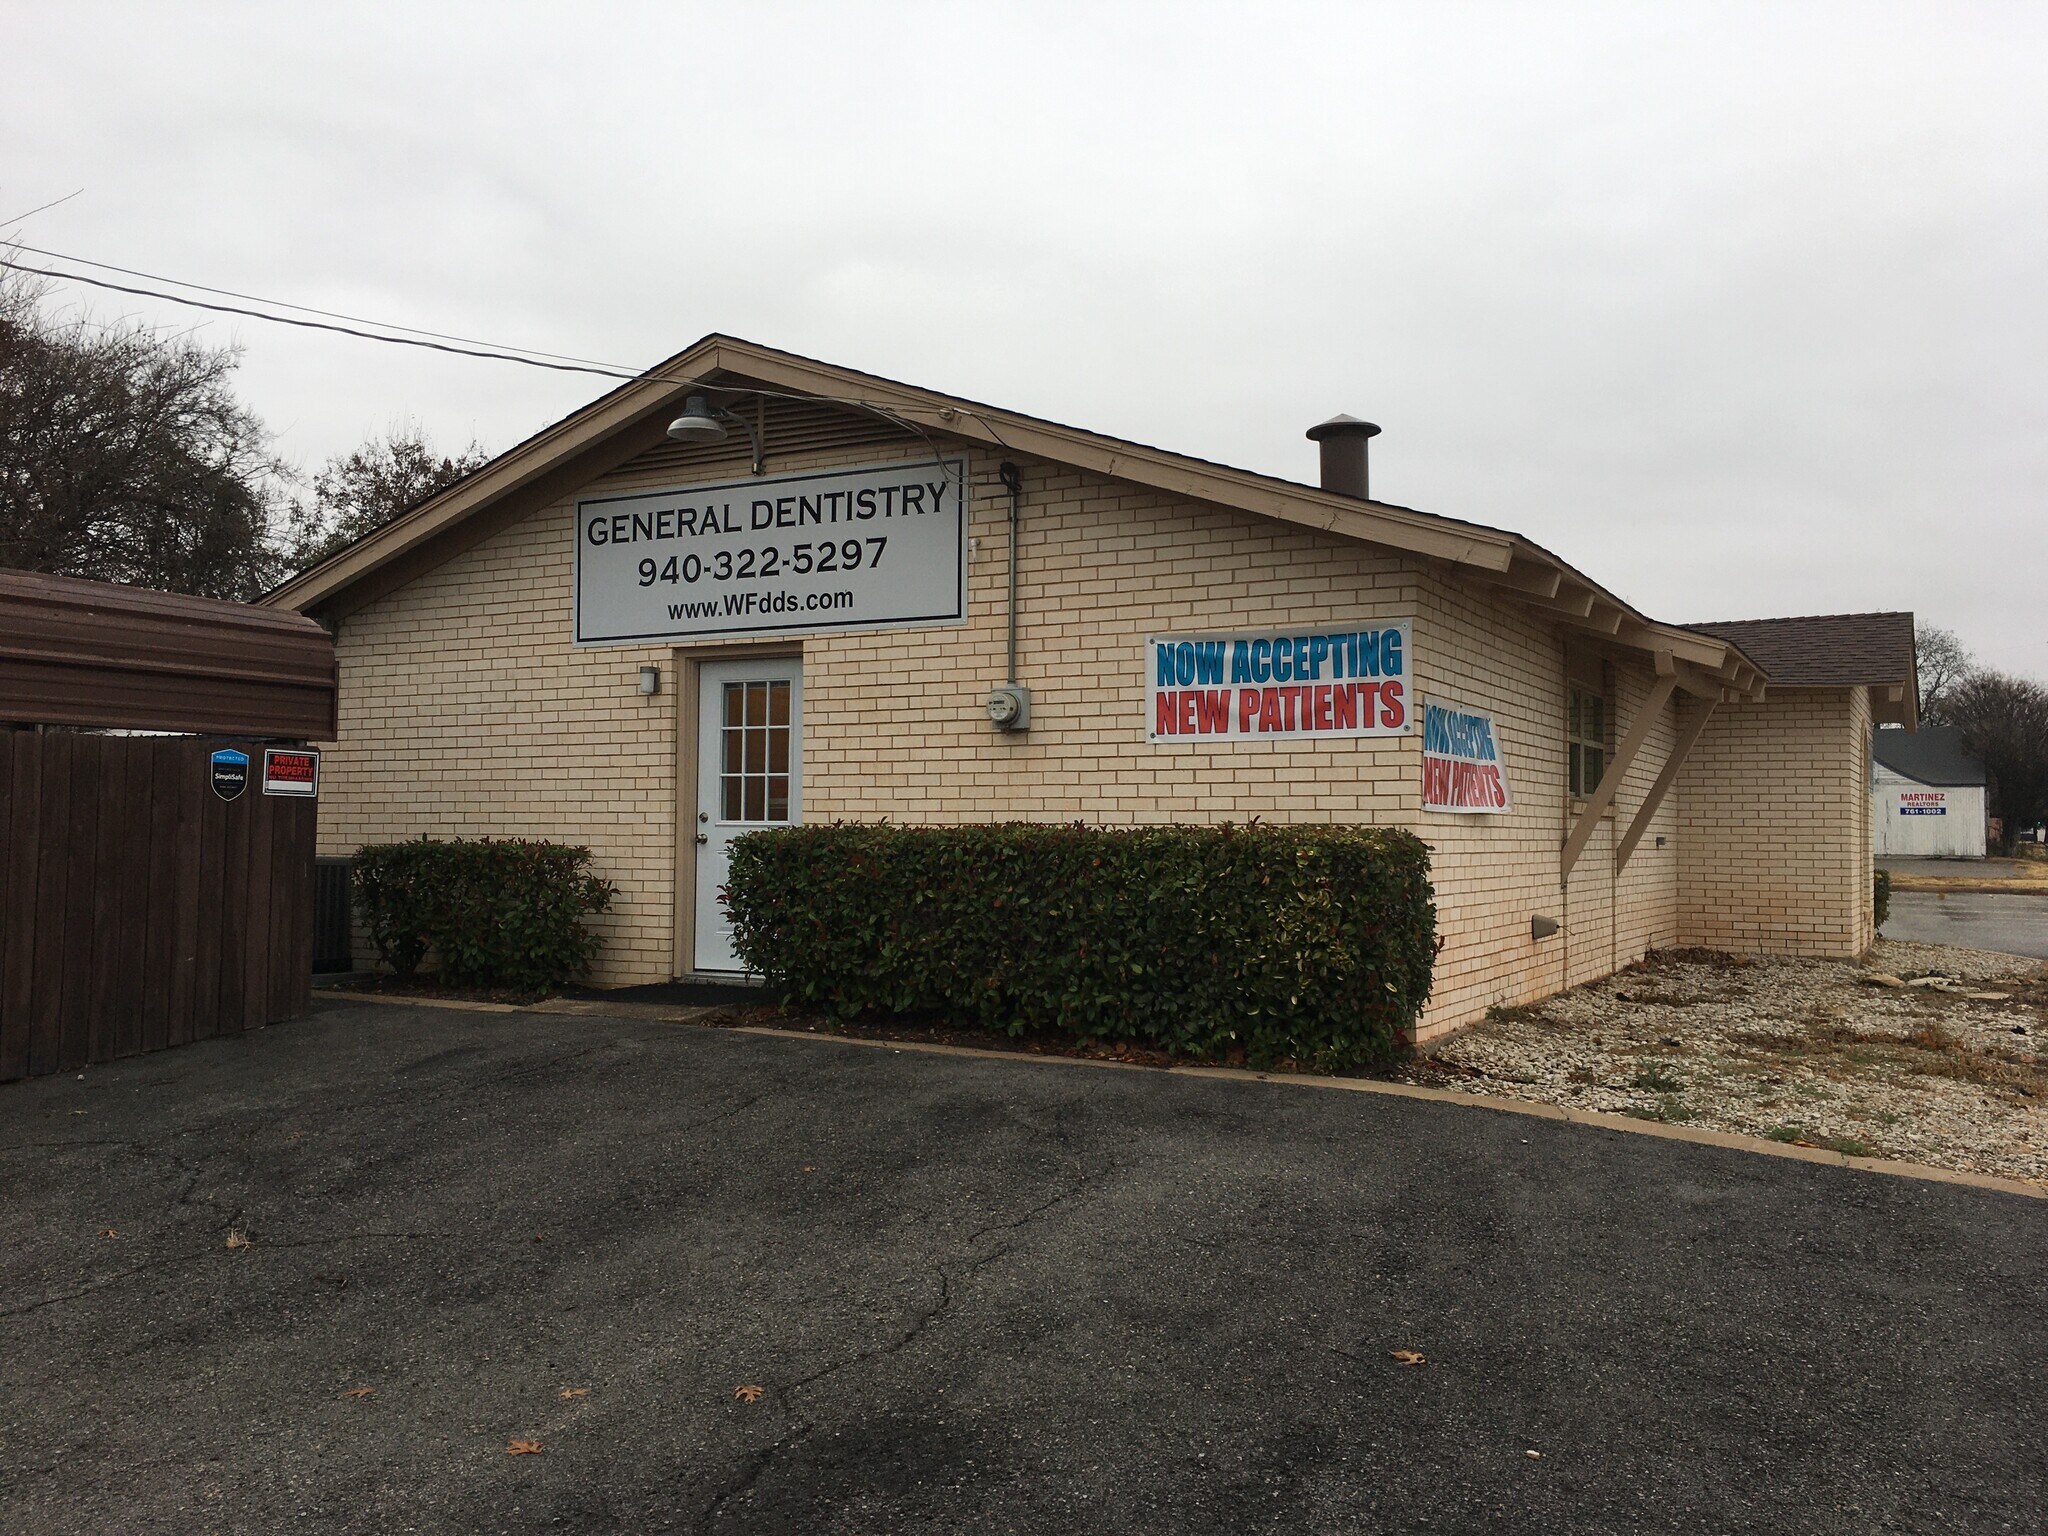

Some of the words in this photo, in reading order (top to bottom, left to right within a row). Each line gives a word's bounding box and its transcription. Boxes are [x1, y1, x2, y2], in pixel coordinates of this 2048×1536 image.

[587, 503, 742, 546] GENERAL
[751, 481, 948, 531] DENTISTRY
[638, 536, 888, 587] 940-322-5297
[667, 588, 854, 620] www.WFdds.com
[1156, 640, 1226, 687] NOW
[1231, 628, 1402, 685] ACCEPTING
[1155, 689, 1231, 735] NEW
[1239, 680, 1405, 733] PATIENTS
[1424, 703, 1449, 754] NOW
[214, 772, 244, 781] SimpliSafe
[268, 765, 313, 777] PROPERTY
[274, 755, 310, 766] PRIVATE
[1423, 756, 1451, 806] NEW
[1450, 760, 1506, 808] PATIENTS
